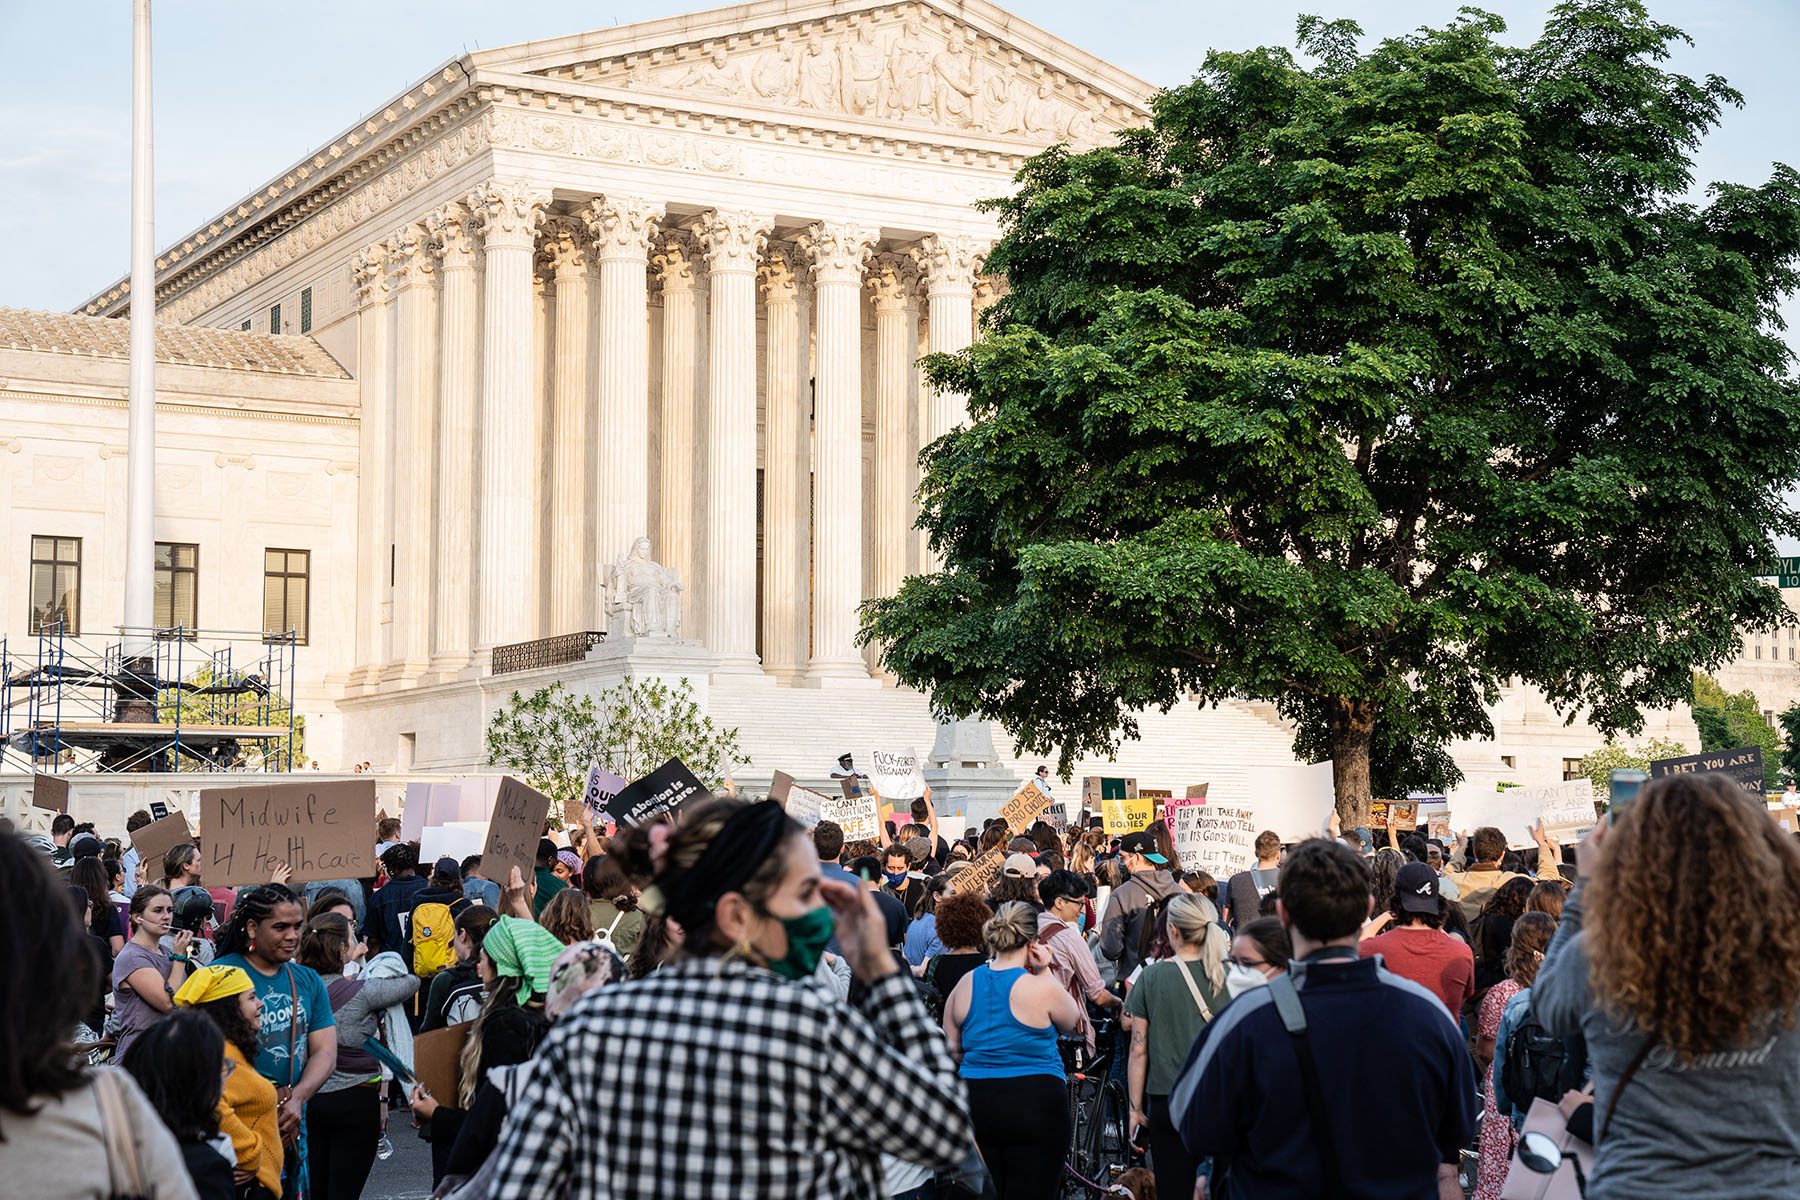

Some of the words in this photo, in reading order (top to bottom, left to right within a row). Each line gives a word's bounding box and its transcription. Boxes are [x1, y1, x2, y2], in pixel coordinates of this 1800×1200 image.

[1754, 558, 1800, 575] MARYL
[873, 751, 896, 765] FUCK
[1663, 766, 1669, 776] I
[1673, 762, 1698, 774] BET
[1702, 758, 1725, 770] YOU
[1729, 753, 1755, 766] ARE
[630, 787, 674, 818] Abortion
[670, 780, 685, 792] is
[667, 785, 698, 808] Care.
[1002, 798, 1021, 817] GOD
[1020, 787, 1036, 802] IS
[220, 793, 340, 829] Midwife
[829, 804, 872, 818] ABORTION
[1108, 805, 1132, 813] BANS
[1127, 812, 1148, 820] OUR
[1179, 807, 1195, 819] THEY
[1197, 807, 1213, 817] WILL
[1217, 807, 1234, 817] TAKE
[1235, 808, 1254, 820] AWAY
[843, 820, 866, 832] AFE
[1009, 810, 1026, 828] PRO
[1110, 819, 1144, 828] BODIES
[1196, 818, 1219, 829] RIGHTS
[1219, 820, 1237, 830] AND
[1237, 820, 1256, 832] TELL
[213, 843, 235, 876] 4
[1203, 849, 1220, 861] LET
[1222, 850, 1246, 865] THEM
[951, 867, 974, 886] MIND
[1416, 882, 1432, 895] A
